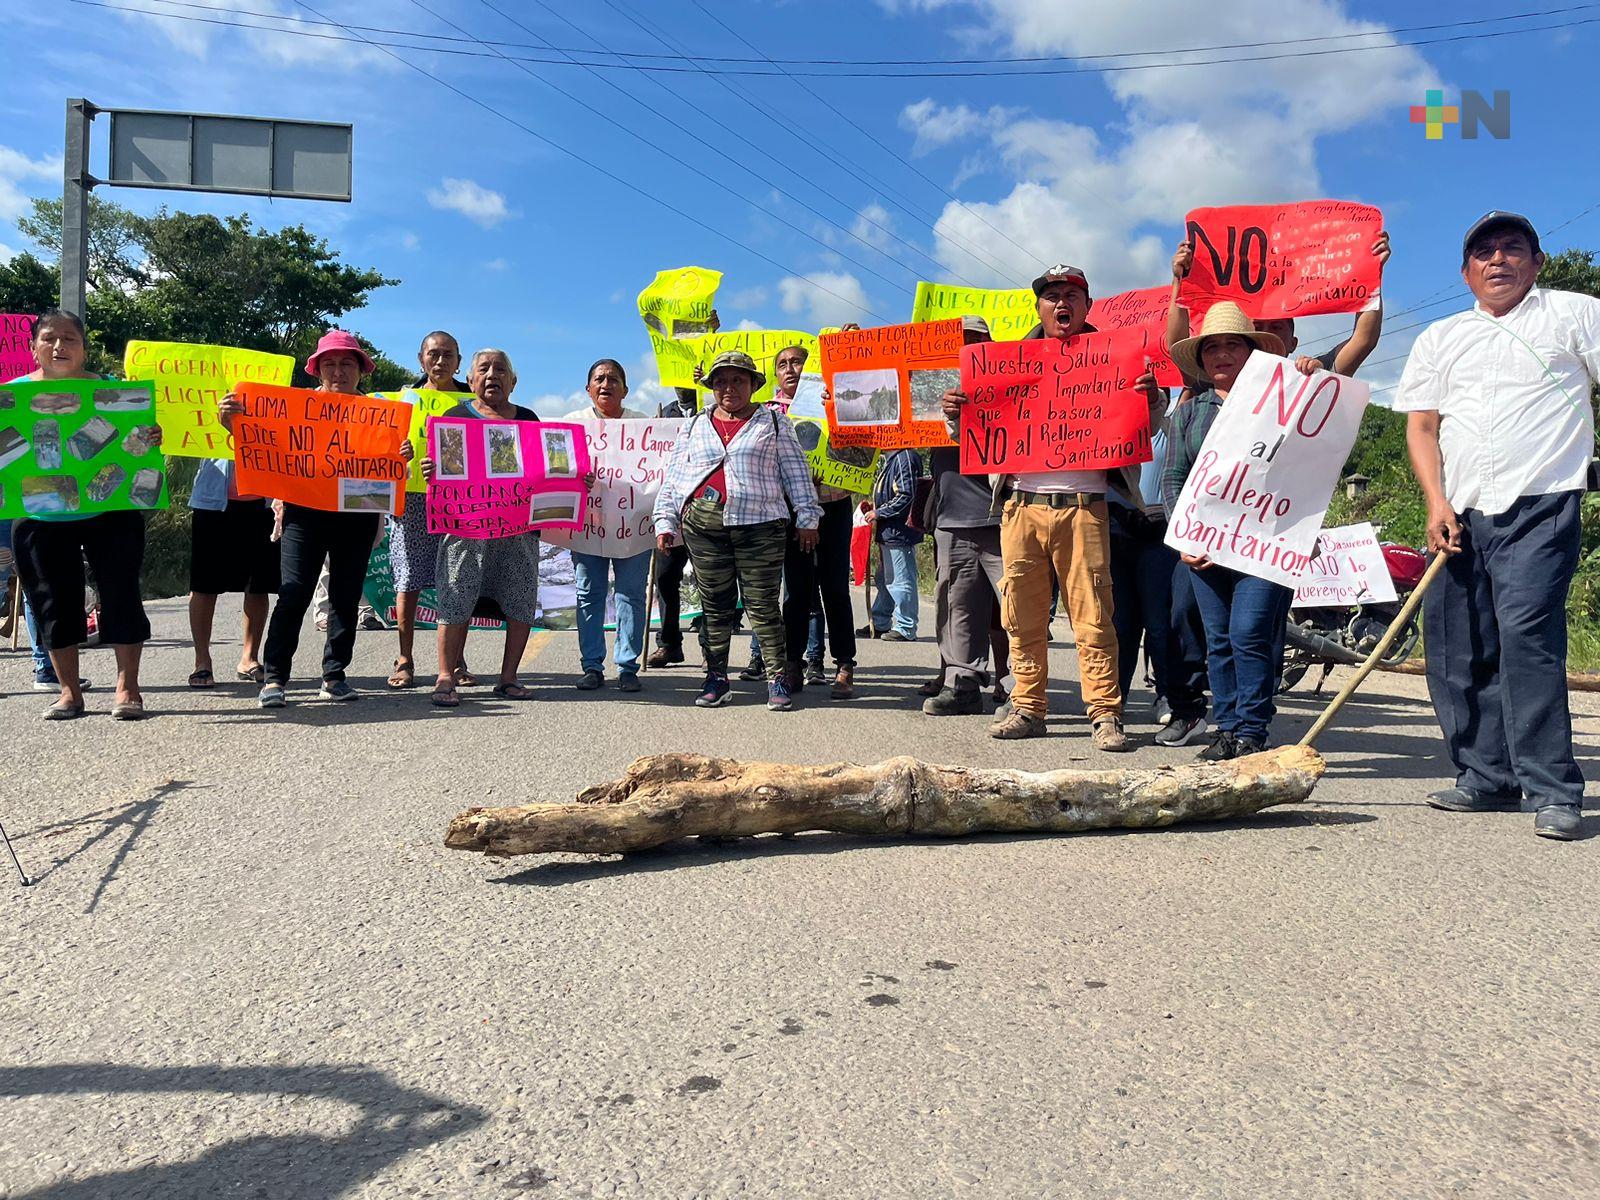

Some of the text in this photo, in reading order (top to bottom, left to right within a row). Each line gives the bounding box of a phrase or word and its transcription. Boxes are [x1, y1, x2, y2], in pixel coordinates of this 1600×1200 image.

[1185, 221, 1268, 294] NO
[1272, 270, 1286, 286] al
[5, 316, 32, 333] NO
[877, 326, 917, 343] FLORA
[925, 320, 962, 336] FAUNA
[703, 335, 731, 354] NO
[734, 333, 756, 353] AL
[827, 345, 874, 362] ESTAN
[882, 345, 900, 356] EN
[132, 347, 285, 382] GOBERNADORA
[971, 338, 1112, 379] Nuestra Salud
[974, 366, 1128, 407] es mas Importante
[1252, 362, 1341, 438] NO
[242, 393, 399, 429] LOMA CAMALOTAL
[976, 408, 1003, 429] que
[1017, 400, 1031, 421] la
[289, 425, 315, 452] NO
[326, 430, 356, 455] AL
[620, 424, 635, 451] la
[641, 425, 680, 457] Cance
[965, 423, 1092, 467] NO al Relleno
[1250, 433, 1286, 463] al
[240, 446, 404, 480] RELLENO SANITARIO
[631, 457, 669, 485] San
[618, 486, 634, 510] el
[1190, 450, 1291, 523] Relleno
[431, 516, 510, 531] NUESTRA
[616, 516, 633, 540] de
[1320, 534, 1373, 553] Basurero
[1309, 555, 1367, 576] NO lo
